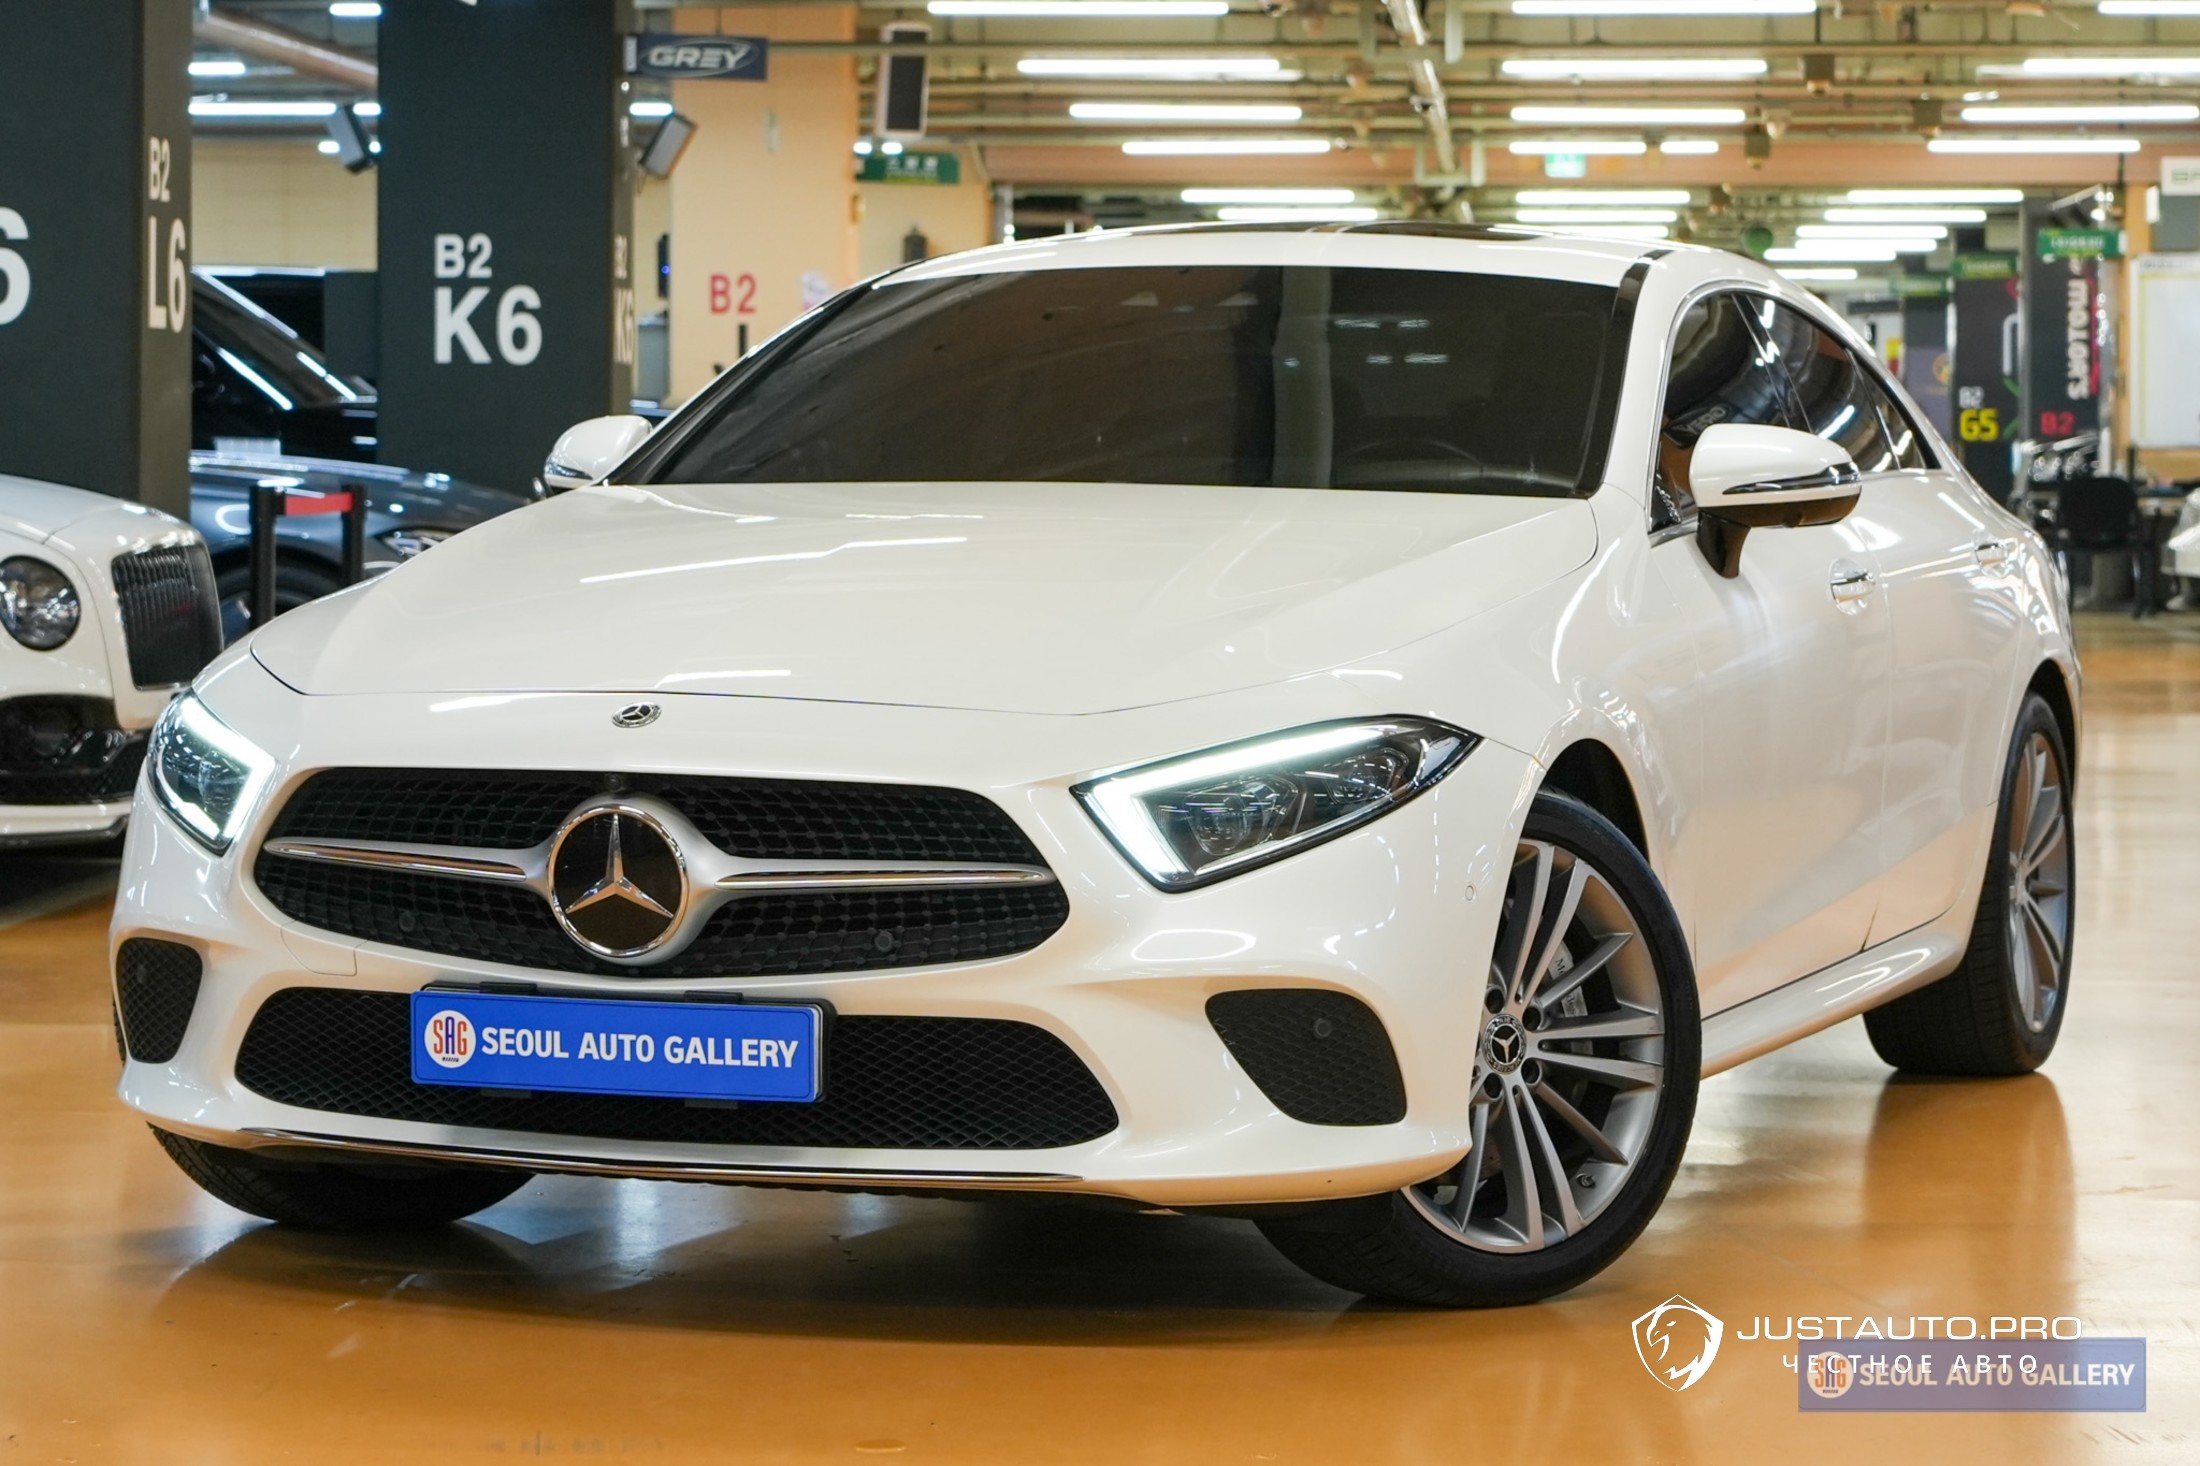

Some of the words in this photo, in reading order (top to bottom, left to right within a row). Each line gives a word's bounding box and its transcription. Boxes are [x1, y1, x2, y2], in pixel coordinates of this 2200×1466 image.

[648, 43, 752, 70] GREY
[148, 136, 171, 203] B2
[148, 215, 187, 334] L6
[434, 233, 493, 279] B2
[710, 273, 758, 315] B2
[434, 284, 543, 367] K6
[613, 287, 634, 365] K6
[2040, 410, 2076, 436] B2
[433, 1016, 467, 1056] SAG
[481, 1026, 569, 1060] SEOUL
[578, 1032, 655, 1063] AUTO
[664, 1035, 798, 1069] GALLERY
